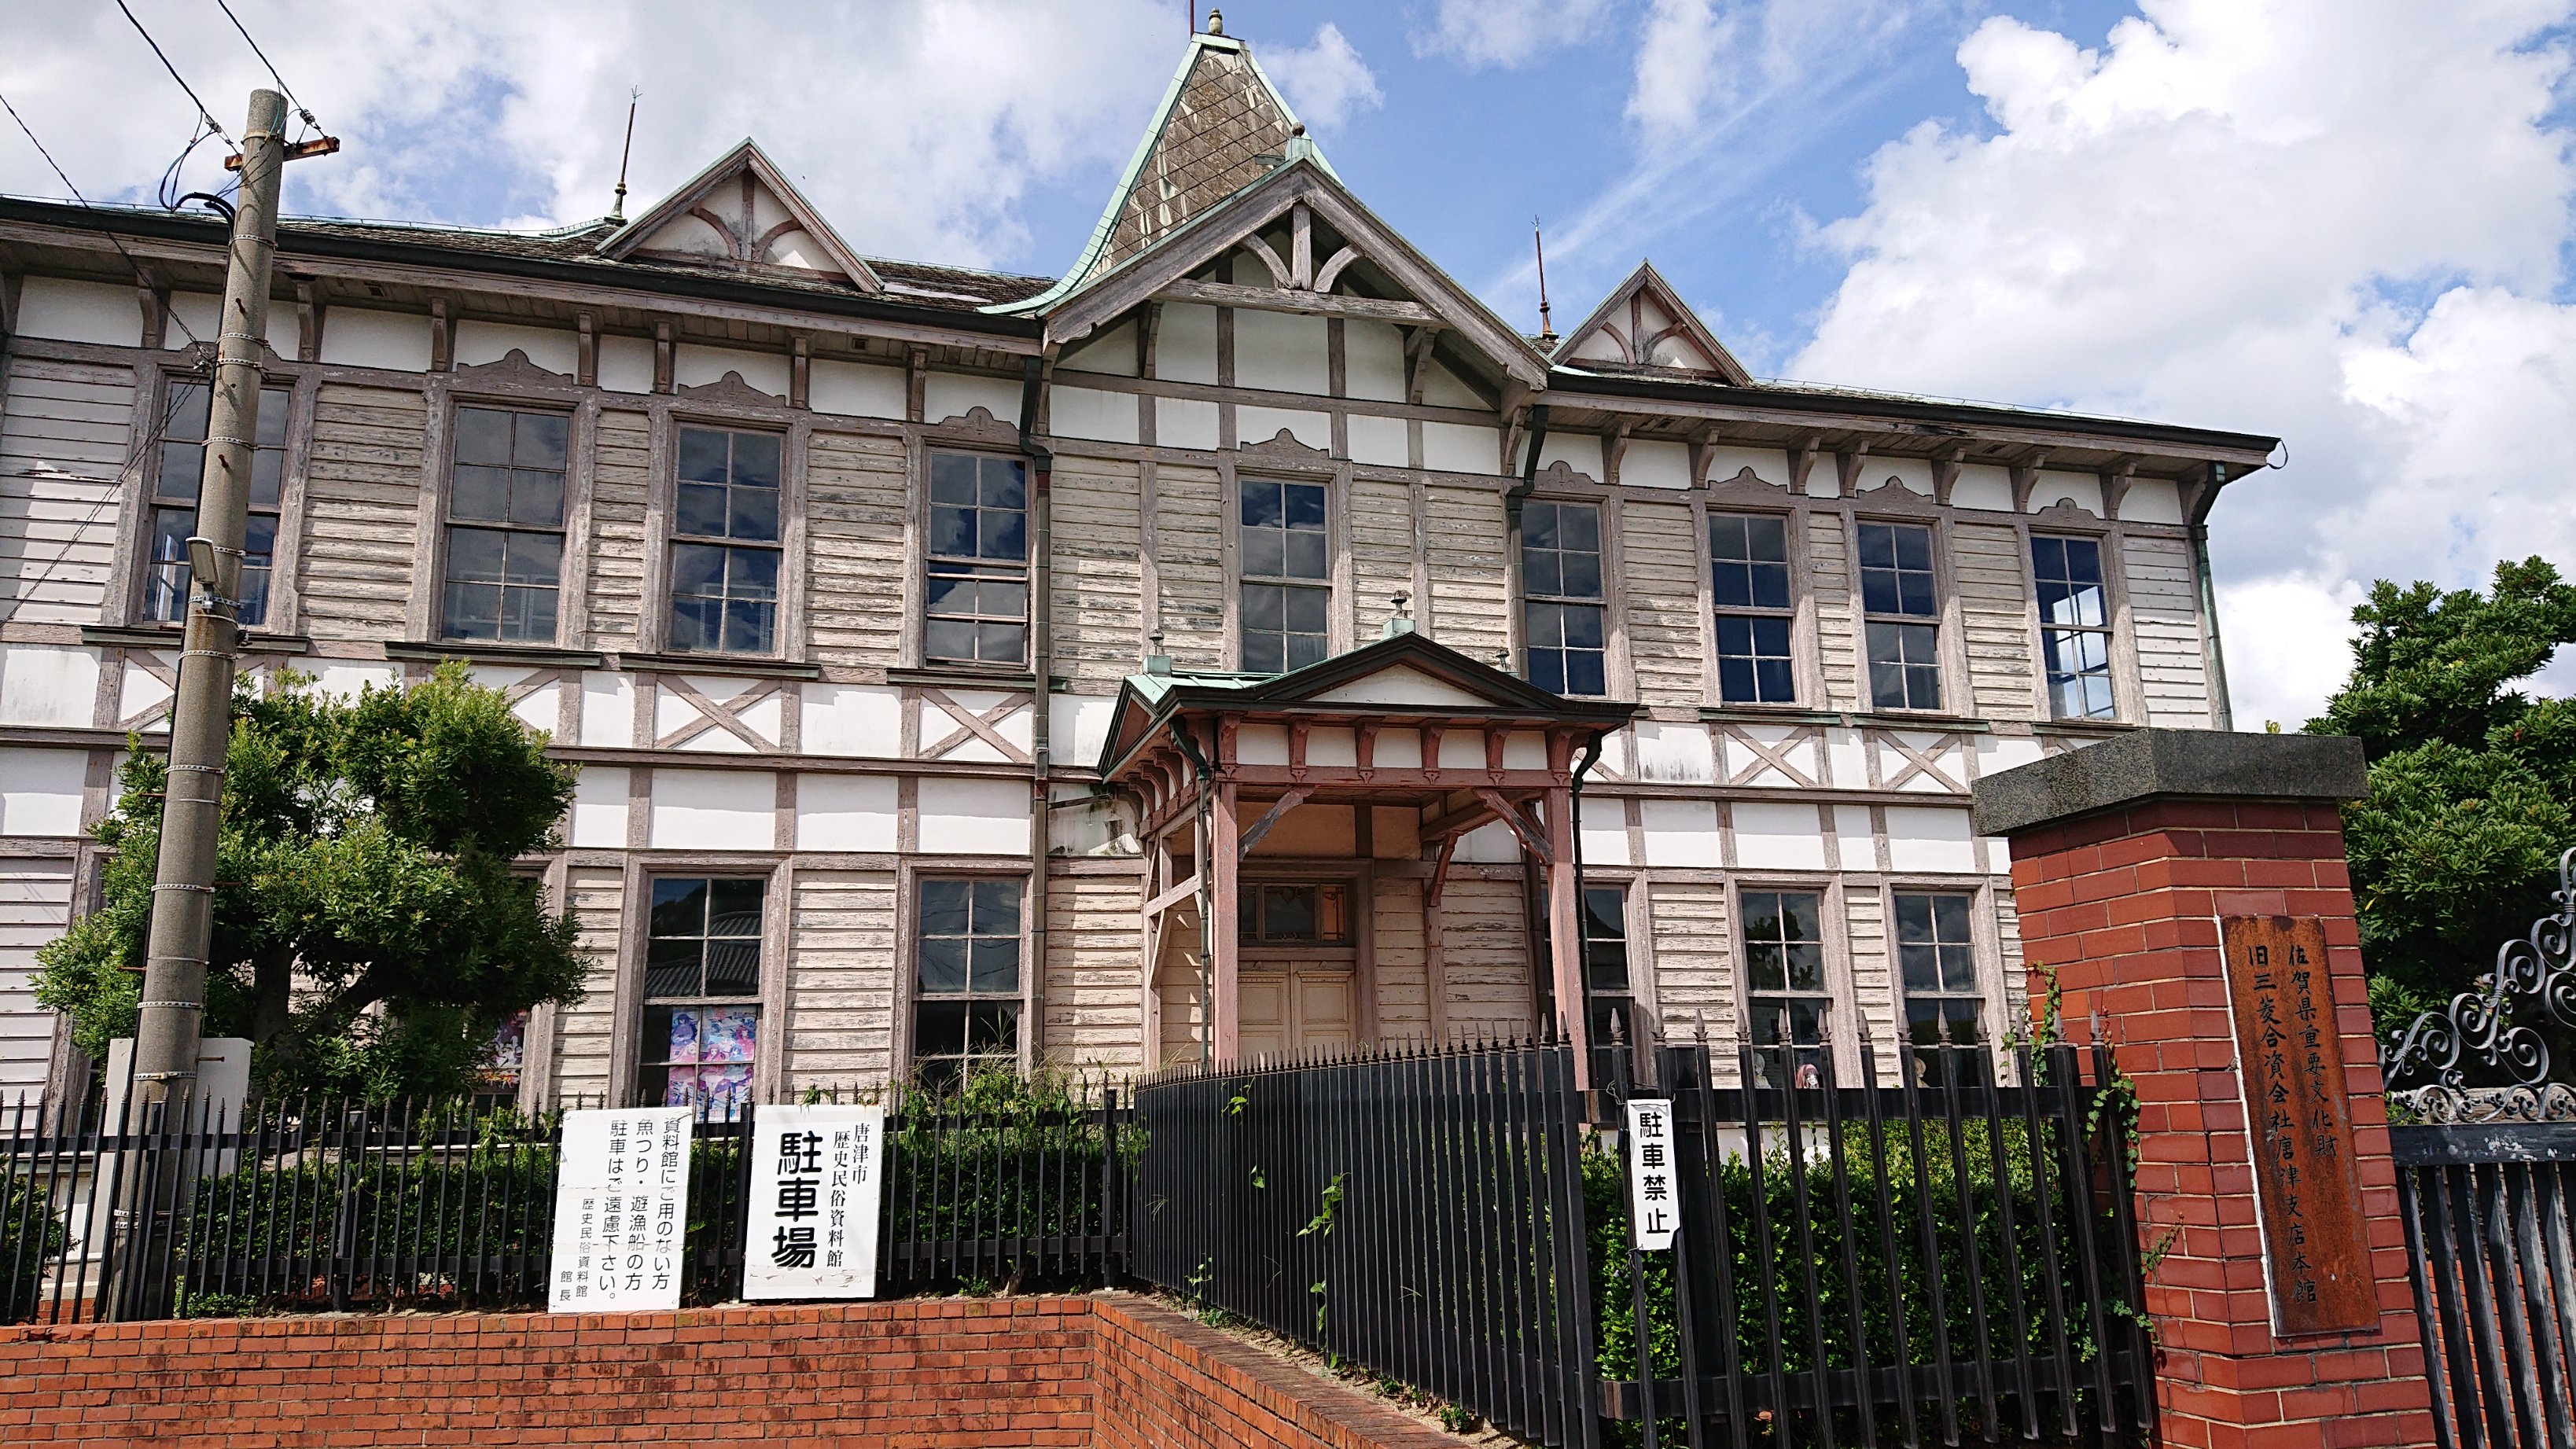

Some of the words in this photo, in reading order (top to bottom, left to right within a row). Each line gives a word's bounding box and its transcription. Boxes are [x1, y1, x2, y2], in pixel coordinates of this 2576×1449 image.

[2287, 944, 2338, 1159] 佐賀県重要文化財
[852, 1123, 870, 1186] 唐津市
[1639, 1111, 1670, 1234] 駐車禁止
[2247, 945, 2318, 1304] 旧三菱合資会社唐津支店本館
[576, 1197, 595, 1298] 歴史民俗資料館
[599, 1120, 627, 1300] 駐車はご遠慮下さい。
[651, 1116, 681, 1290] 資料館にご用のない方
[771, 1130, 823, 1270] 駐車場
[826, 1130, 850, 1268] 歴史民俗資料館
[558, 1271, 573, 1302] 館長
